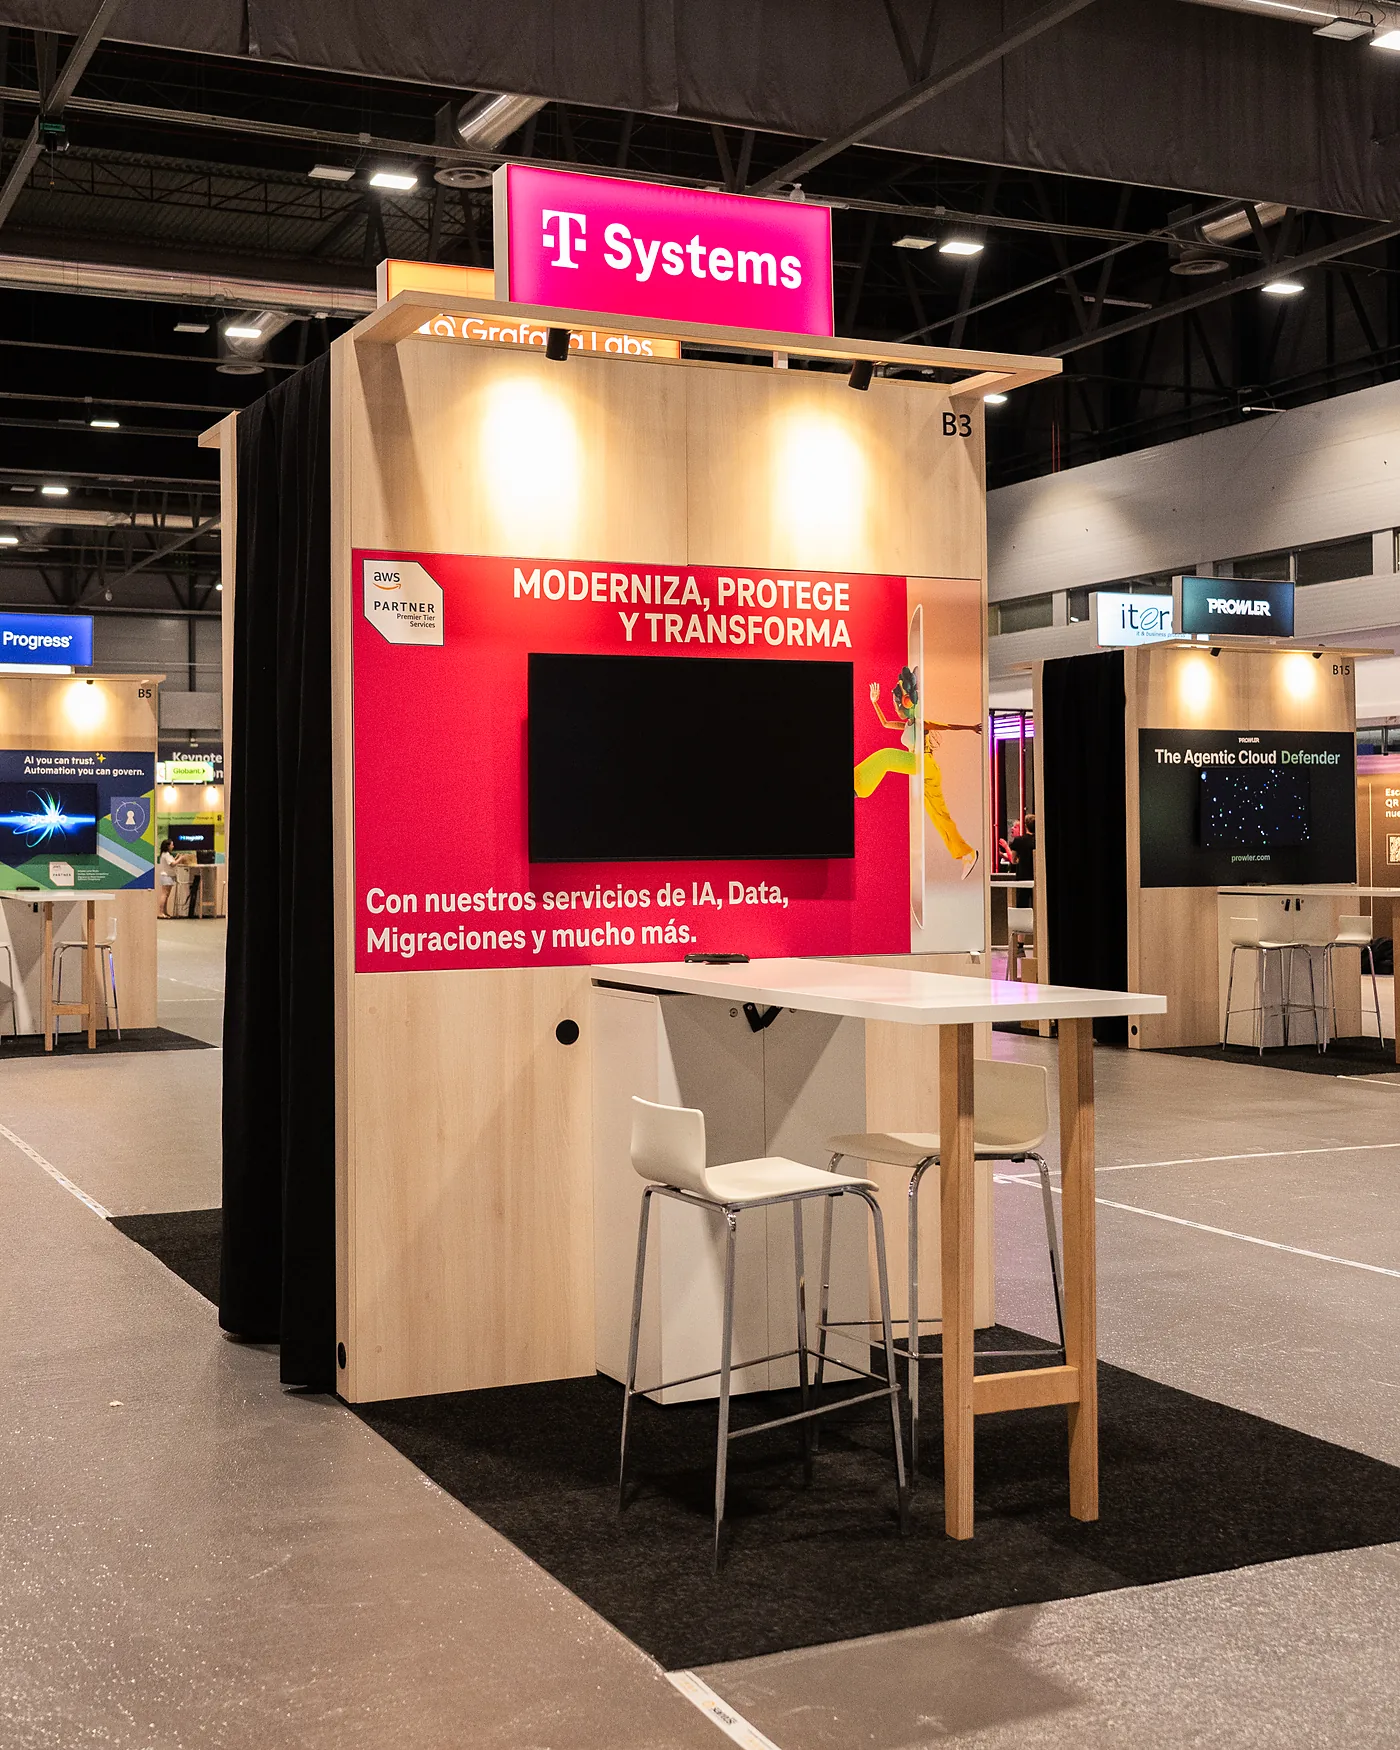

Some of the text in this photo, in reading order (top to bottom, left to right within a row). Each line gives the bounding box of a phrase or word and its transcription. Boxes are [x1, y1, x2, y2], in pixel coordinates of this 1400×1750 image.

[604, 222, 802, 290] Systems
[462, 317, 583, 349] Grafaa
[942, 412, 972, 437] B3
[373, 571, 401, 582] aws
[513, 567, 850, 612] MODERNIZA, PROTEGE
[373, 601, 435, 613] PARTNER
[1206, 598, 1272, 616] PROWLER
[396, 613, 422, 621] Premier
[410, 621, 436, 629] Services
[1121, 604, 1173, 630] iter
[618, 611, 853, 648] Y TRANSFORMA
[3, 631, 70, 650] Progress
[1332, 664, 1350, 675] B15
[138, 688, 152, 698] B5
[24, 756, 34, 764] AI
[36, 758, 52, 766] you
[72, 756, 95, 765] trust.
[1154, 749, 1341, 767] The Agentic Cloud Defender
[24, 766, 145, 777] Automation you can govern.
[1385, 799, 1399, 808] QR
[1231, 854, 1271, 863] prowler.com
[366, 881, 790, 914] Con nuestros servicios de IA, Data,
[367, 918, 698, 958] Migraciones y mucho más.
